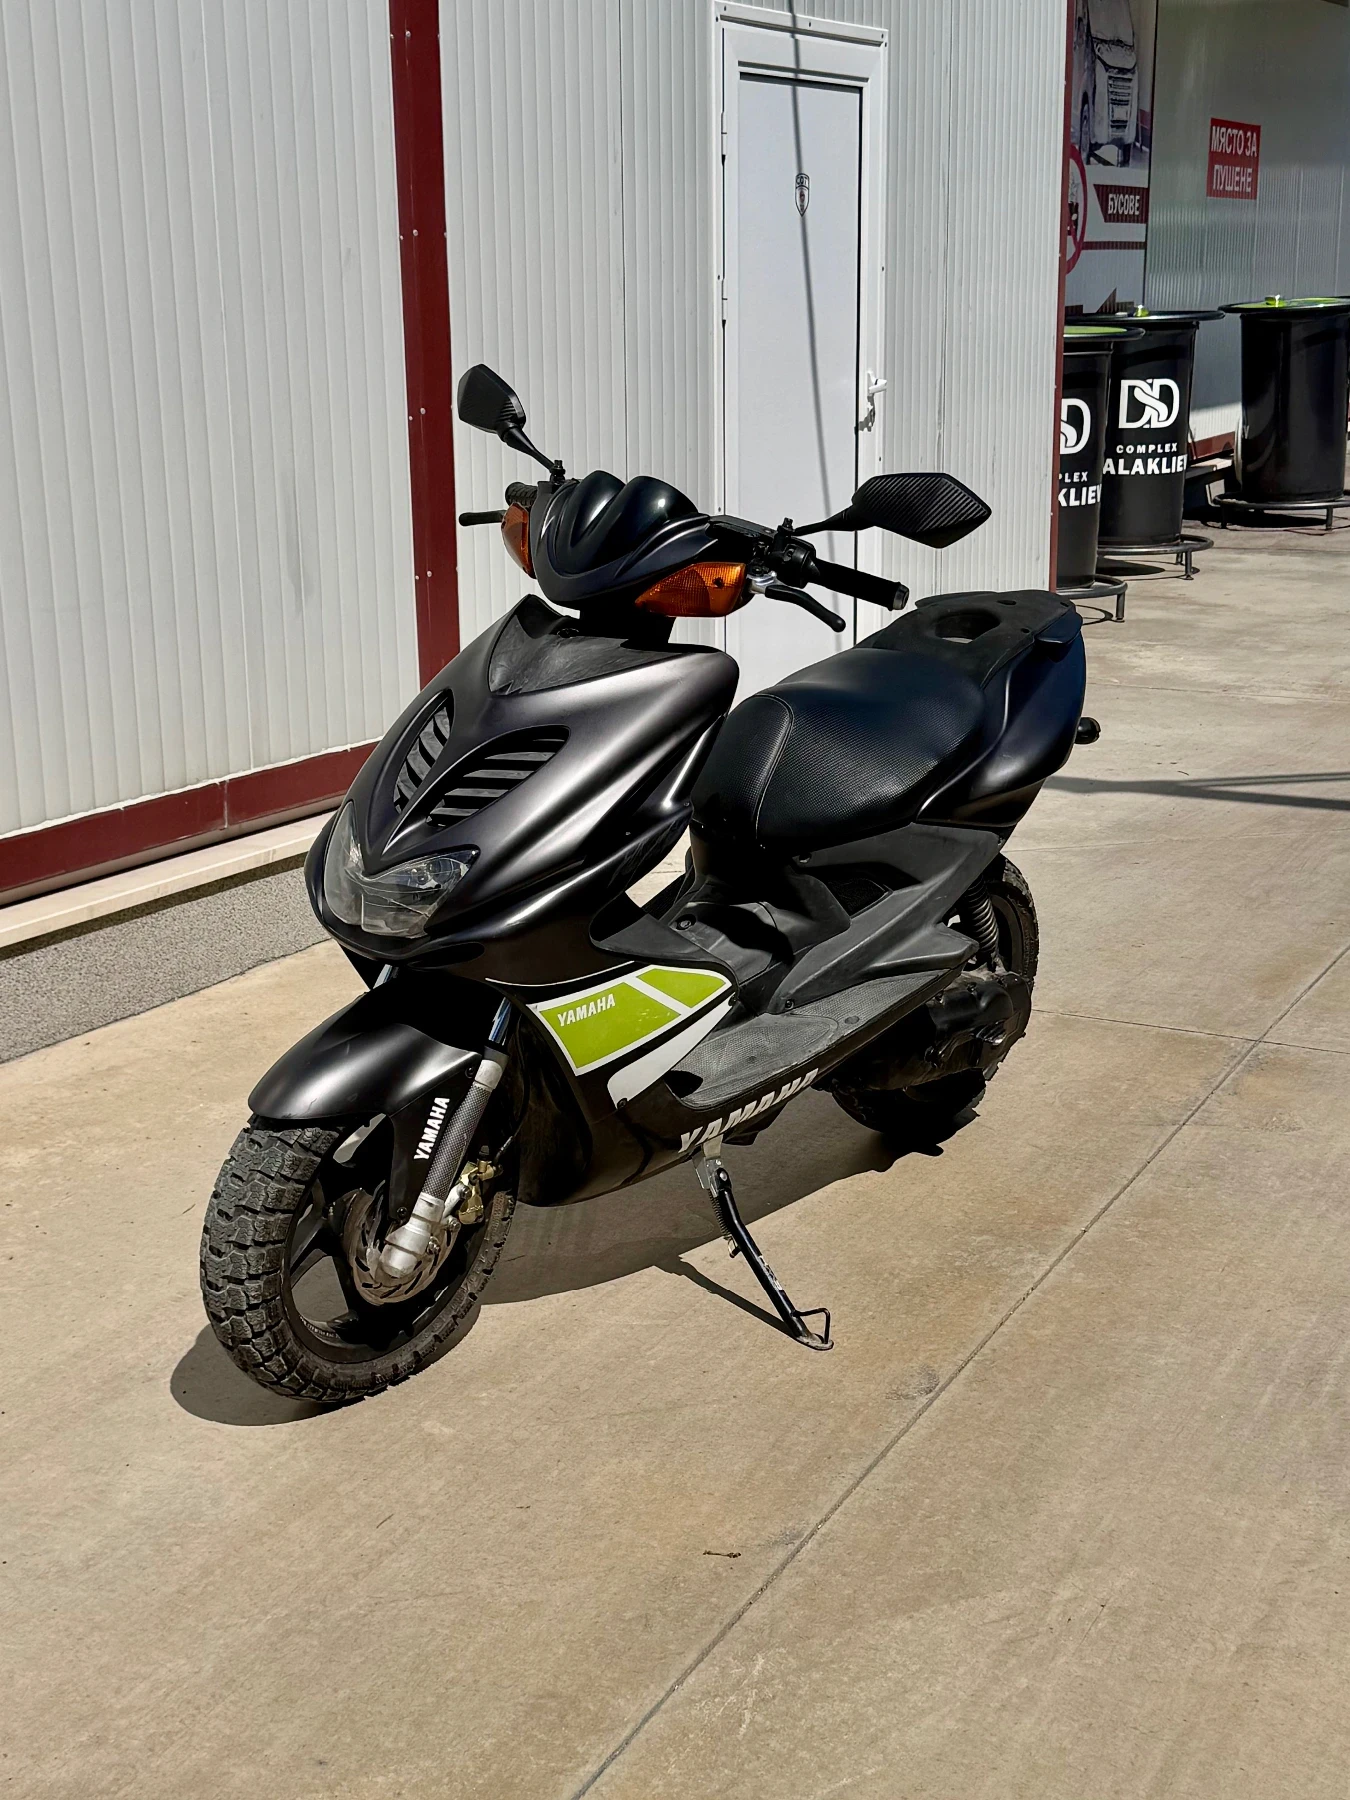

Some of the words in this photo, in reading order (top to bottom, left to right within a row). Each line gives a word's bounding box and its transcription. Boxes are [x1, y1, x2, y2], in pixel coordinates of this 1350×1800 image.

[1211, 126, 1244, 155] МЯСТО
[1245, 132, 1257, 157] ЗА
[1213, 165, 1252, 192] ПУШЕНЕ
[1108, 194, 1140, 215] БУСОВЕ
[1116, 443, 1177, 454] COMPLEX
[557, 993, 616, 1027] YAMAHA
[678, 1067, 819, 1154] YAMAHA
[413, 1097, 450, 1160] YAMAHA
